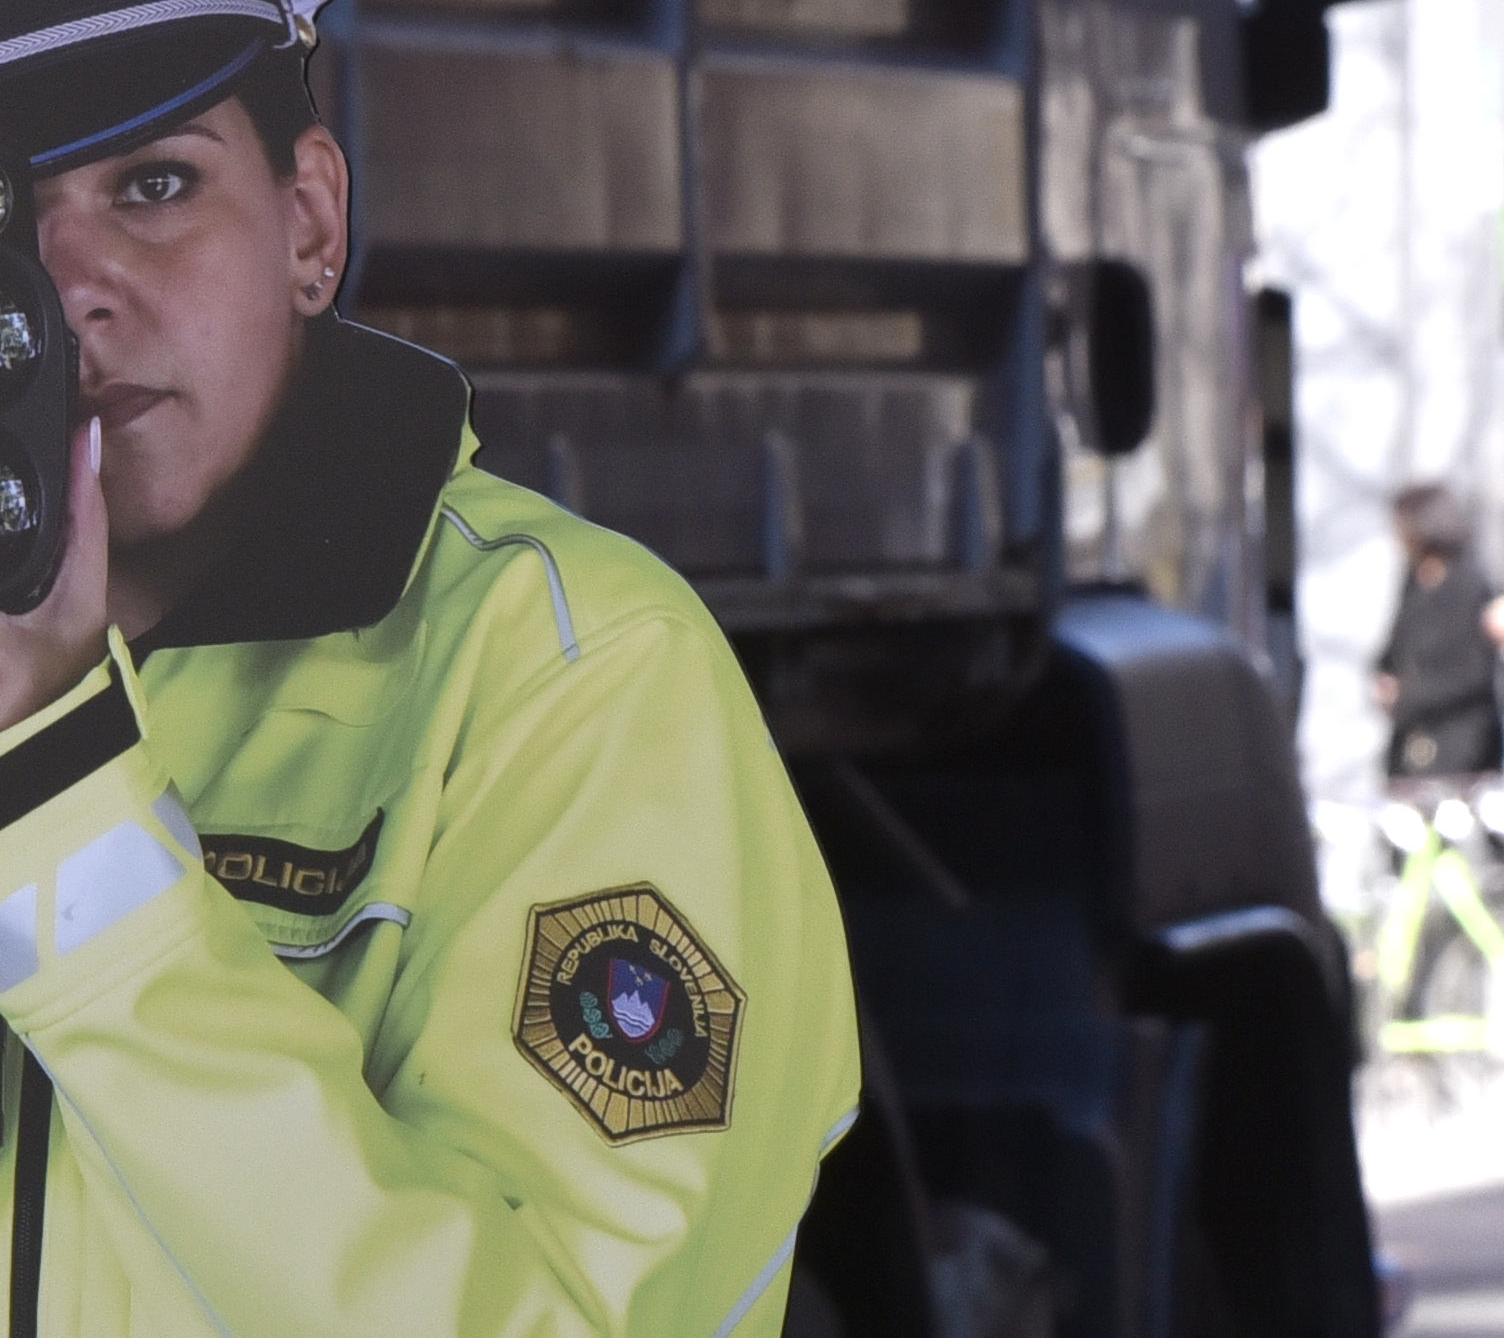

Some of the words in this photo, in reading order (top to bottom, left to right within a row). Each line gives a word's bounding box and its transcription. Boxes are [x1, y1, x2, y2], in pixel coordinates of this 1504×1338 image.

[556, 924, 639, 986] REPUBLIKA
[648, 938, 708, 1038] SLOVENIJA
[568, 1033, 684, 1098] POLICIJA
